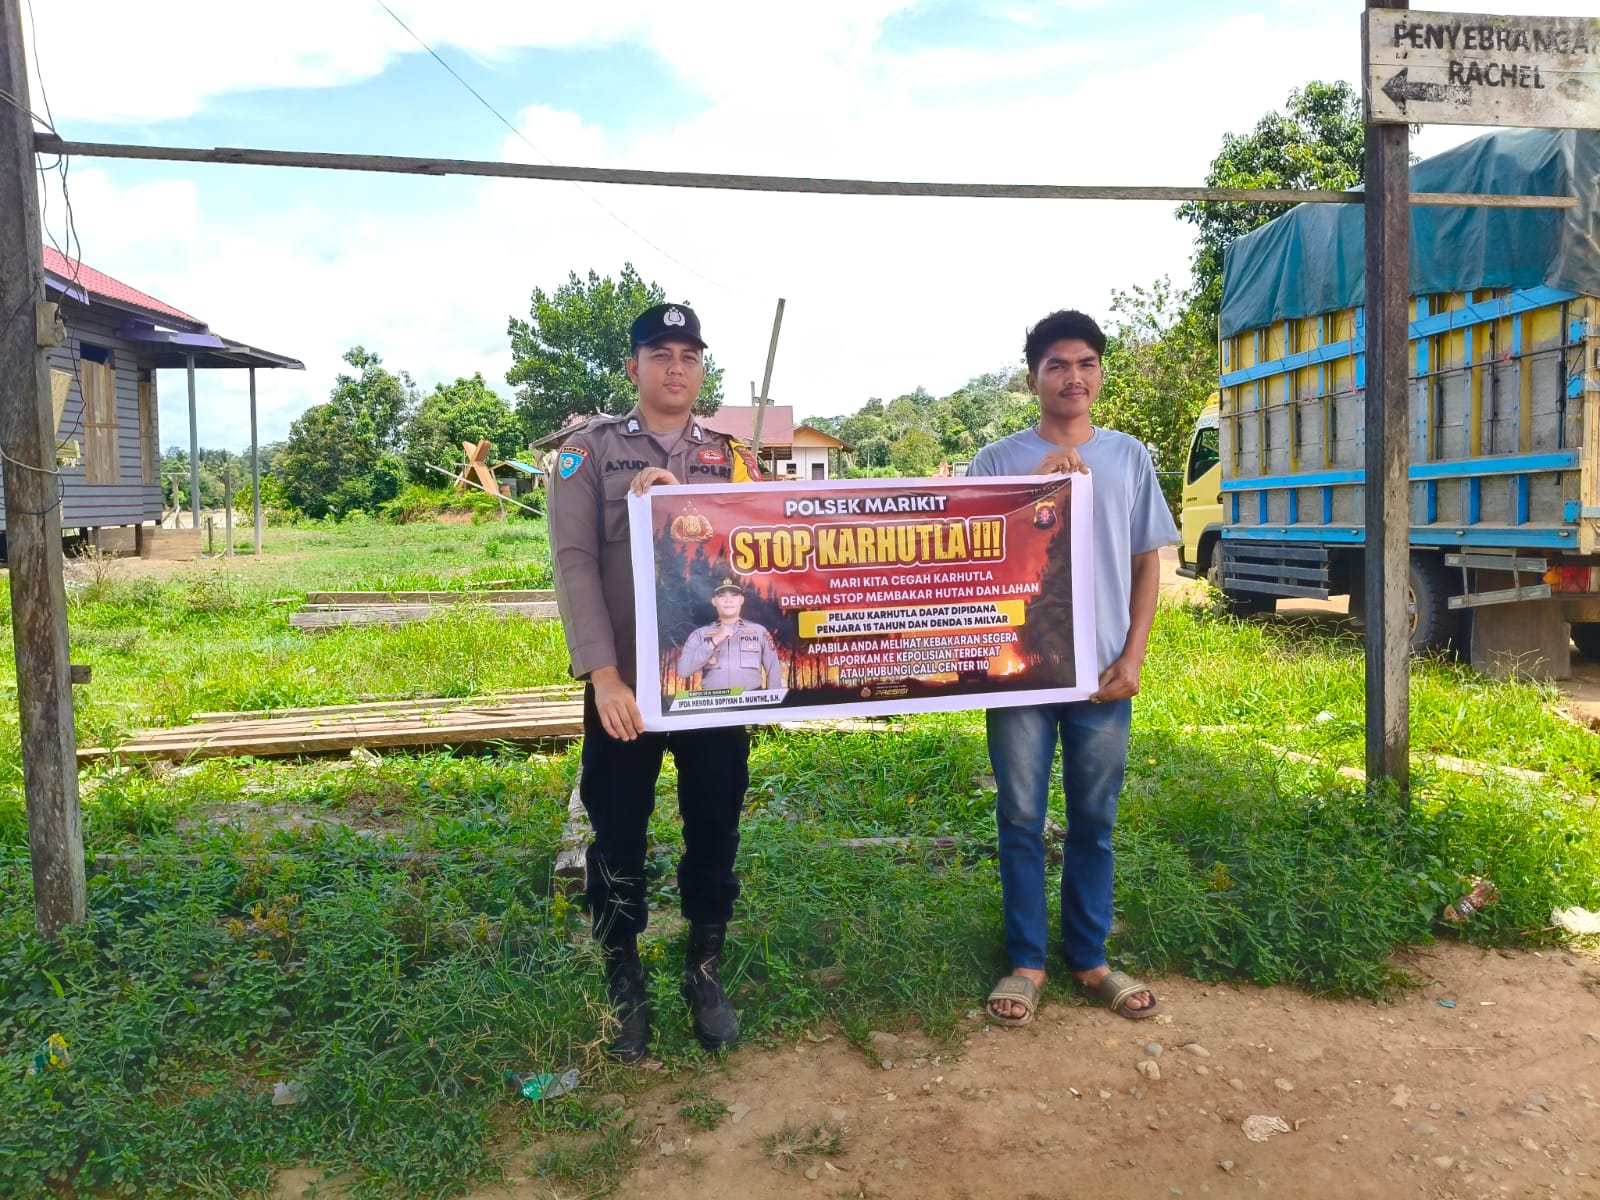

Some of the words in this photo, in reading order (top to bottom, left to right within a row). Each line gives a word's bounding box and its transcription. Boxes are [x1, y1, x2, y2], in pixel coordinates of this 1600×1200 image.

[1449, 60, 1545, 89] RACHEL
[689, 465, 731, 478] POLRI
[785, 498, 861, 516] POLSEK
[865, 496, 947, 513] MARIKIT
[734, 528, 812, 570] STOP
[817, 522, 967, 566] KARHUTLA
[972, 520, 1001, 558] !!!
[829, 578, 860, 589] MARI
[863, 576, 889, 587] KITA
[891, 574, 931, 585] CEGAH
[933, 571, 993, 583] KARHUTLA
[781, 594, 831, 606] DENGAN
[833, 593, 864, 604] STOP
[866, 589, 933, 602] MEMBAKAR
[935, 587, 973, 598] HUTAN
[976, 585, 1000, 596] DAN
[1002, 583, 1039, 594] LAHAN
[828, 612, 865, 621] PELAKU
[867, 609, 918, 619] KARHUTLA
[919, 607, 949, 616] DAPAT
[951, 604, 996, 615] DIPIDANA
[816, 624, 861, 634] PENJARA
[863, 623, 871, 631] 15
[873, 621, 907, 631] TAHUN
[908, 619, 928, 629] DAN
[930, 618, 962, 627] DENDA
[963, 617, 972, 625] 15
[974, 615, 1008, 625] MILYAR
[808, 642, 849, 654] APABILA
[851, 640, 879, 652] ANDA
[880, 637, 921, 649] MELIHAT
[923, 634, 981, 647] KEBAKARAN
[982, 632, 1018, 644] SEGERA
[828, 653, 880, 666] LAPORKAN
[882, 652, 895, 663] KE
[896, 649, 952, 662] KEPOLISIAN
[953, 646, 1000, 658] TERDEKAT
[840, 668, 865, 679] ATAU
[866, 665, 911, 677] HUBUNGI
[913, 663, 936, 674] CALL
[938, 661, 975, 672] CENTER
[976, 660, 989, 670] 110
